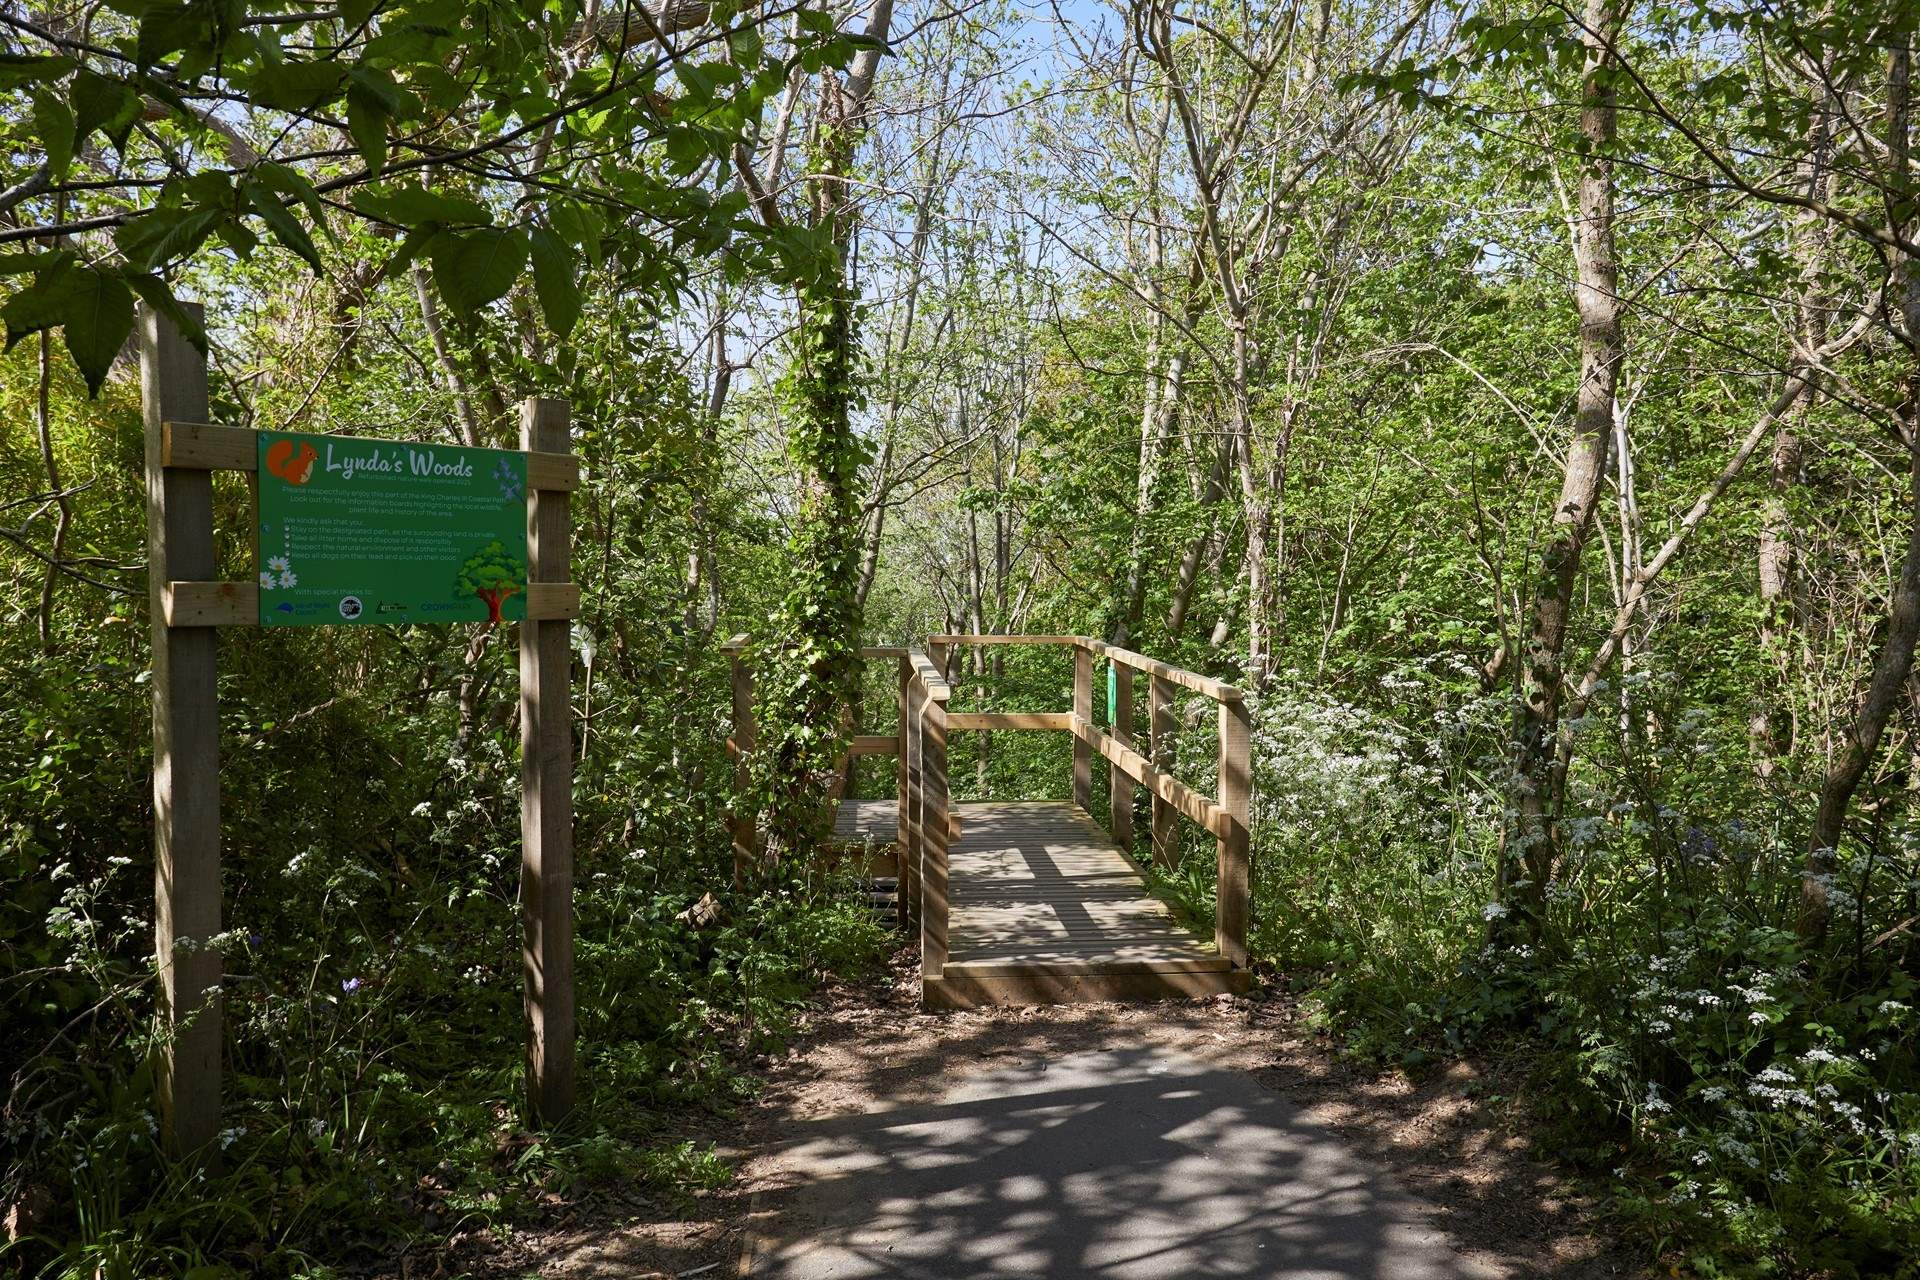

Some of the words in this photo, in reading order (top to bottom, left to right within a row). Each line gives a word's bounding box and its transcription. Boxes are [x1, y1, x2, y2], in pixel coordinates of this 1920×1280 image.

[326, 443, 403, 480] Lynda's
[409, 449, 473, 477] Woods
[351, 490, 370, 499] enjoy
[289, 495, 307, 503] Look
[308, 496, 321, 504] out
[322, 496, 334, 504] for
[334, 497, 347, 505] the
[349, 497, 388, 506] information
[297, 516, 318, 526] kindly
